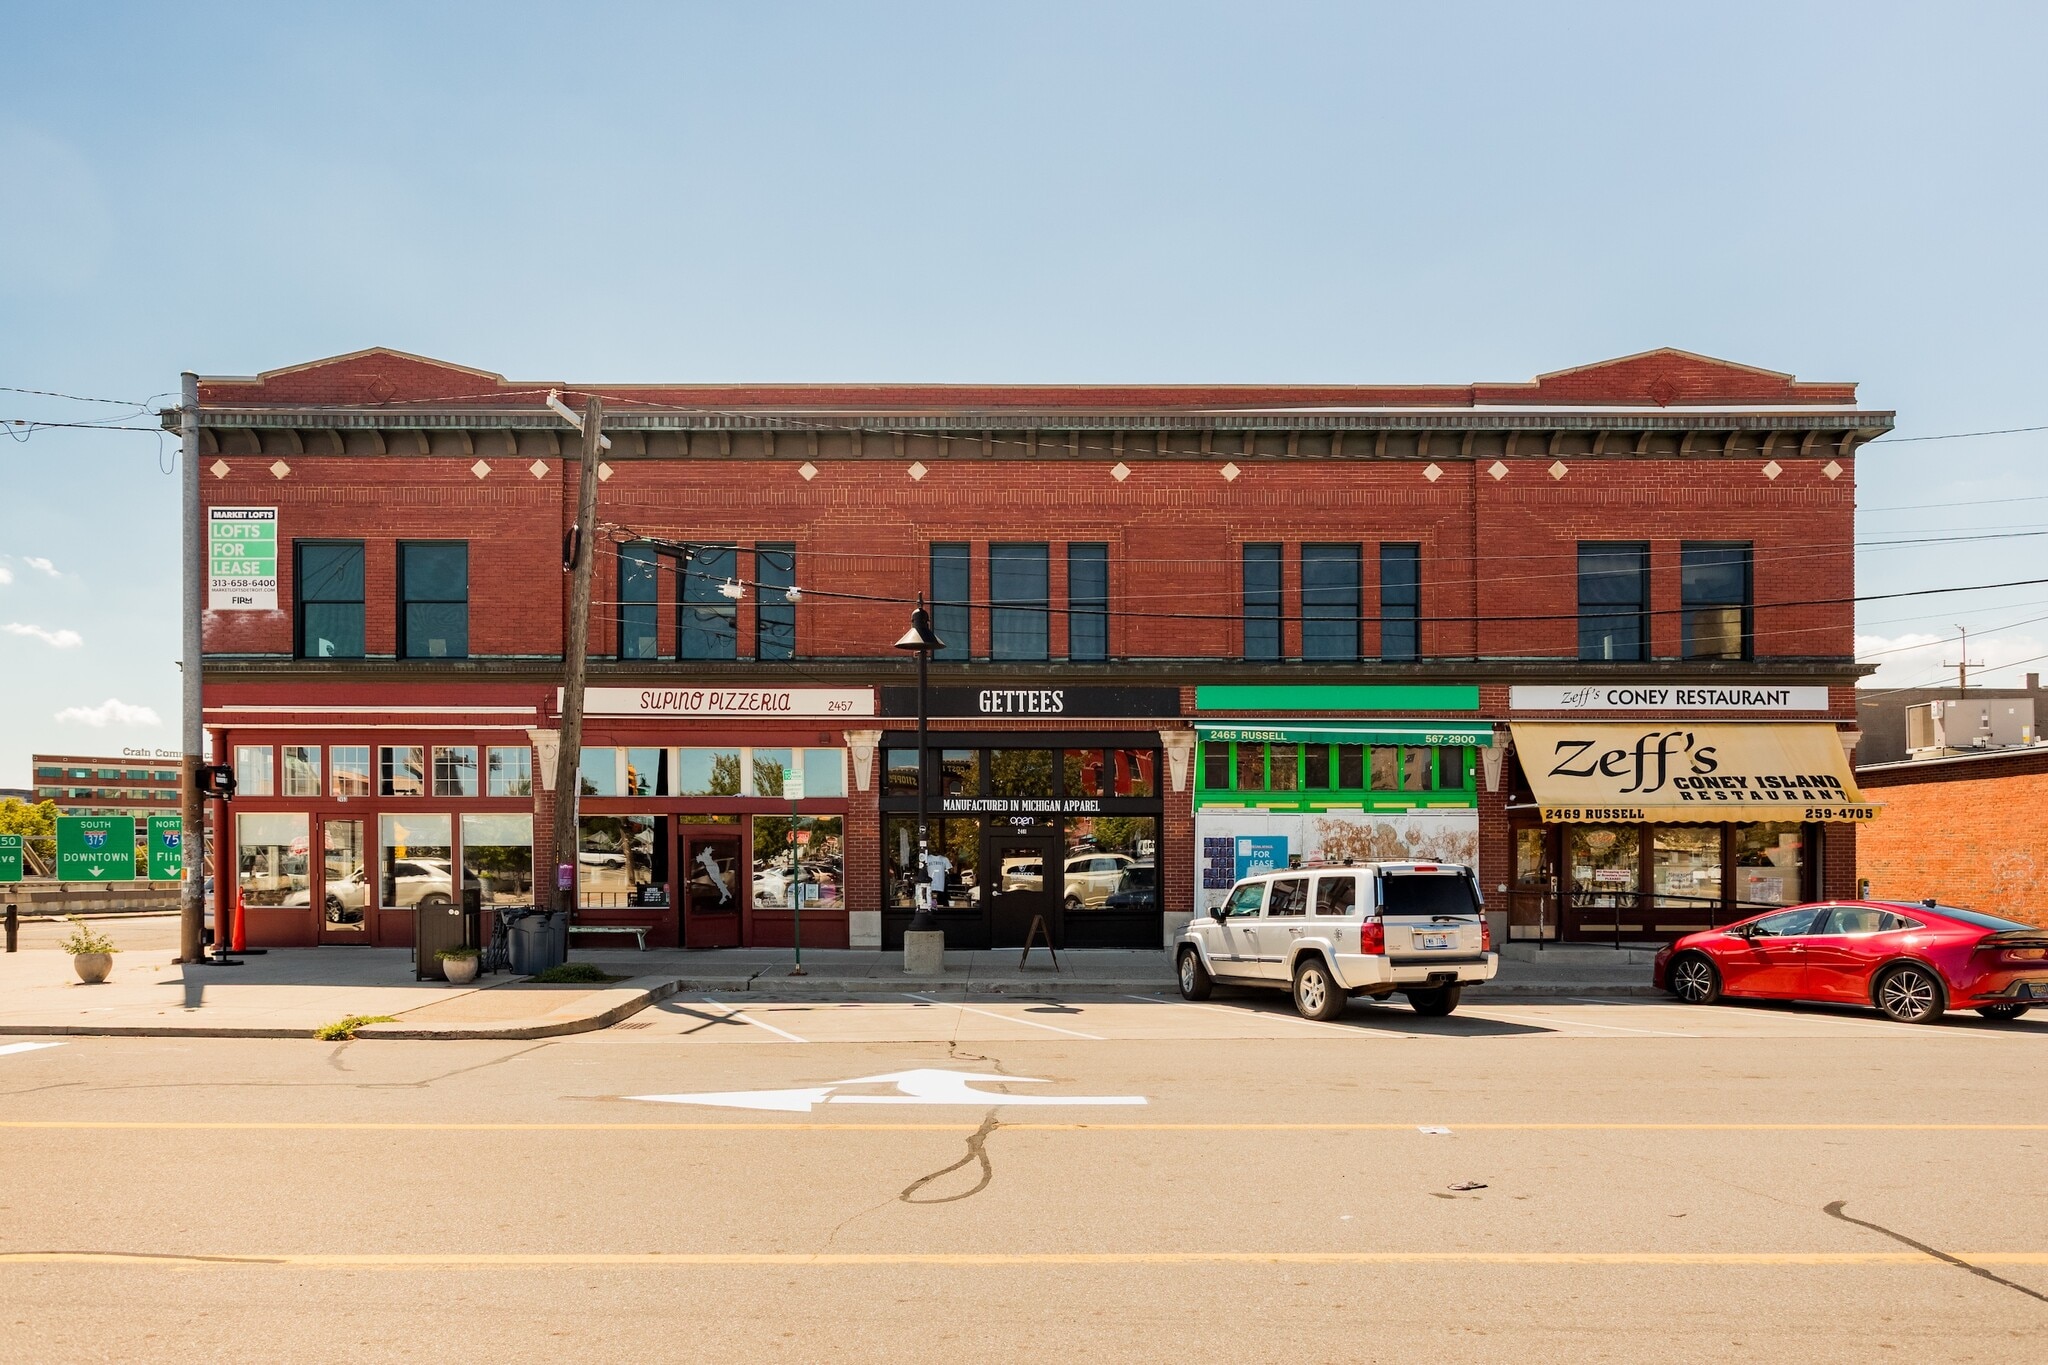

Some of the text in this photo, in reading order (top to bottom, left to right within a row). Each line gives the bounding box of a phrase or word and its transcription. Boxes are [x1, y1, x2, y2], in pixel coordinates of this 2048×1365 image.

[213, 511, 273, 519] MARKET LOFTS
[213, 524, 260, 538] LOFTS
[213, 543, 245, 556] FOR
[213, 561, 260, 575] LEASE
[212, 579, 275, 587] 313-658-6400
[232, 596, 252, 604] FIRM
[708, 692, 791, 711] PIZZERIA
[979, 690, 1064, 713] GETTEES
[1561, 687, 1790, 707] Zeff's CONEY RESTAURANT
[828, 701, 853, 711] 2457
[1211, 731, 1287, 741] 2465 RUSSELL
[1425, 735, 1476, 744] 567-2900
[123, 747, 151, 757] Crain
[1548, 731, 1717, 793] Zeff's
[1673, 775, 1842, 790] CONEY ISLAND
[1679, 790, 1846, 801] RESTAURANT
[943, 799, 1100, 812] MANUFACTURED IN MICHIGAN APPAREL
[1546, 809, 1644, 819] 2469 RUSSELL
[1805, 808, 1873, 819] 259-4705
[88, 834, 104, 846] 375
[165, 834, 180, 846] 75
[0, 855, 15, 863] ve
[64, 853, 128, 862] DOWNTOWN
[157, 852, 181, 862] Flin
[1253, 850, 1270, 859] FOR
[1249, 860, 1275, 868] LEASE
